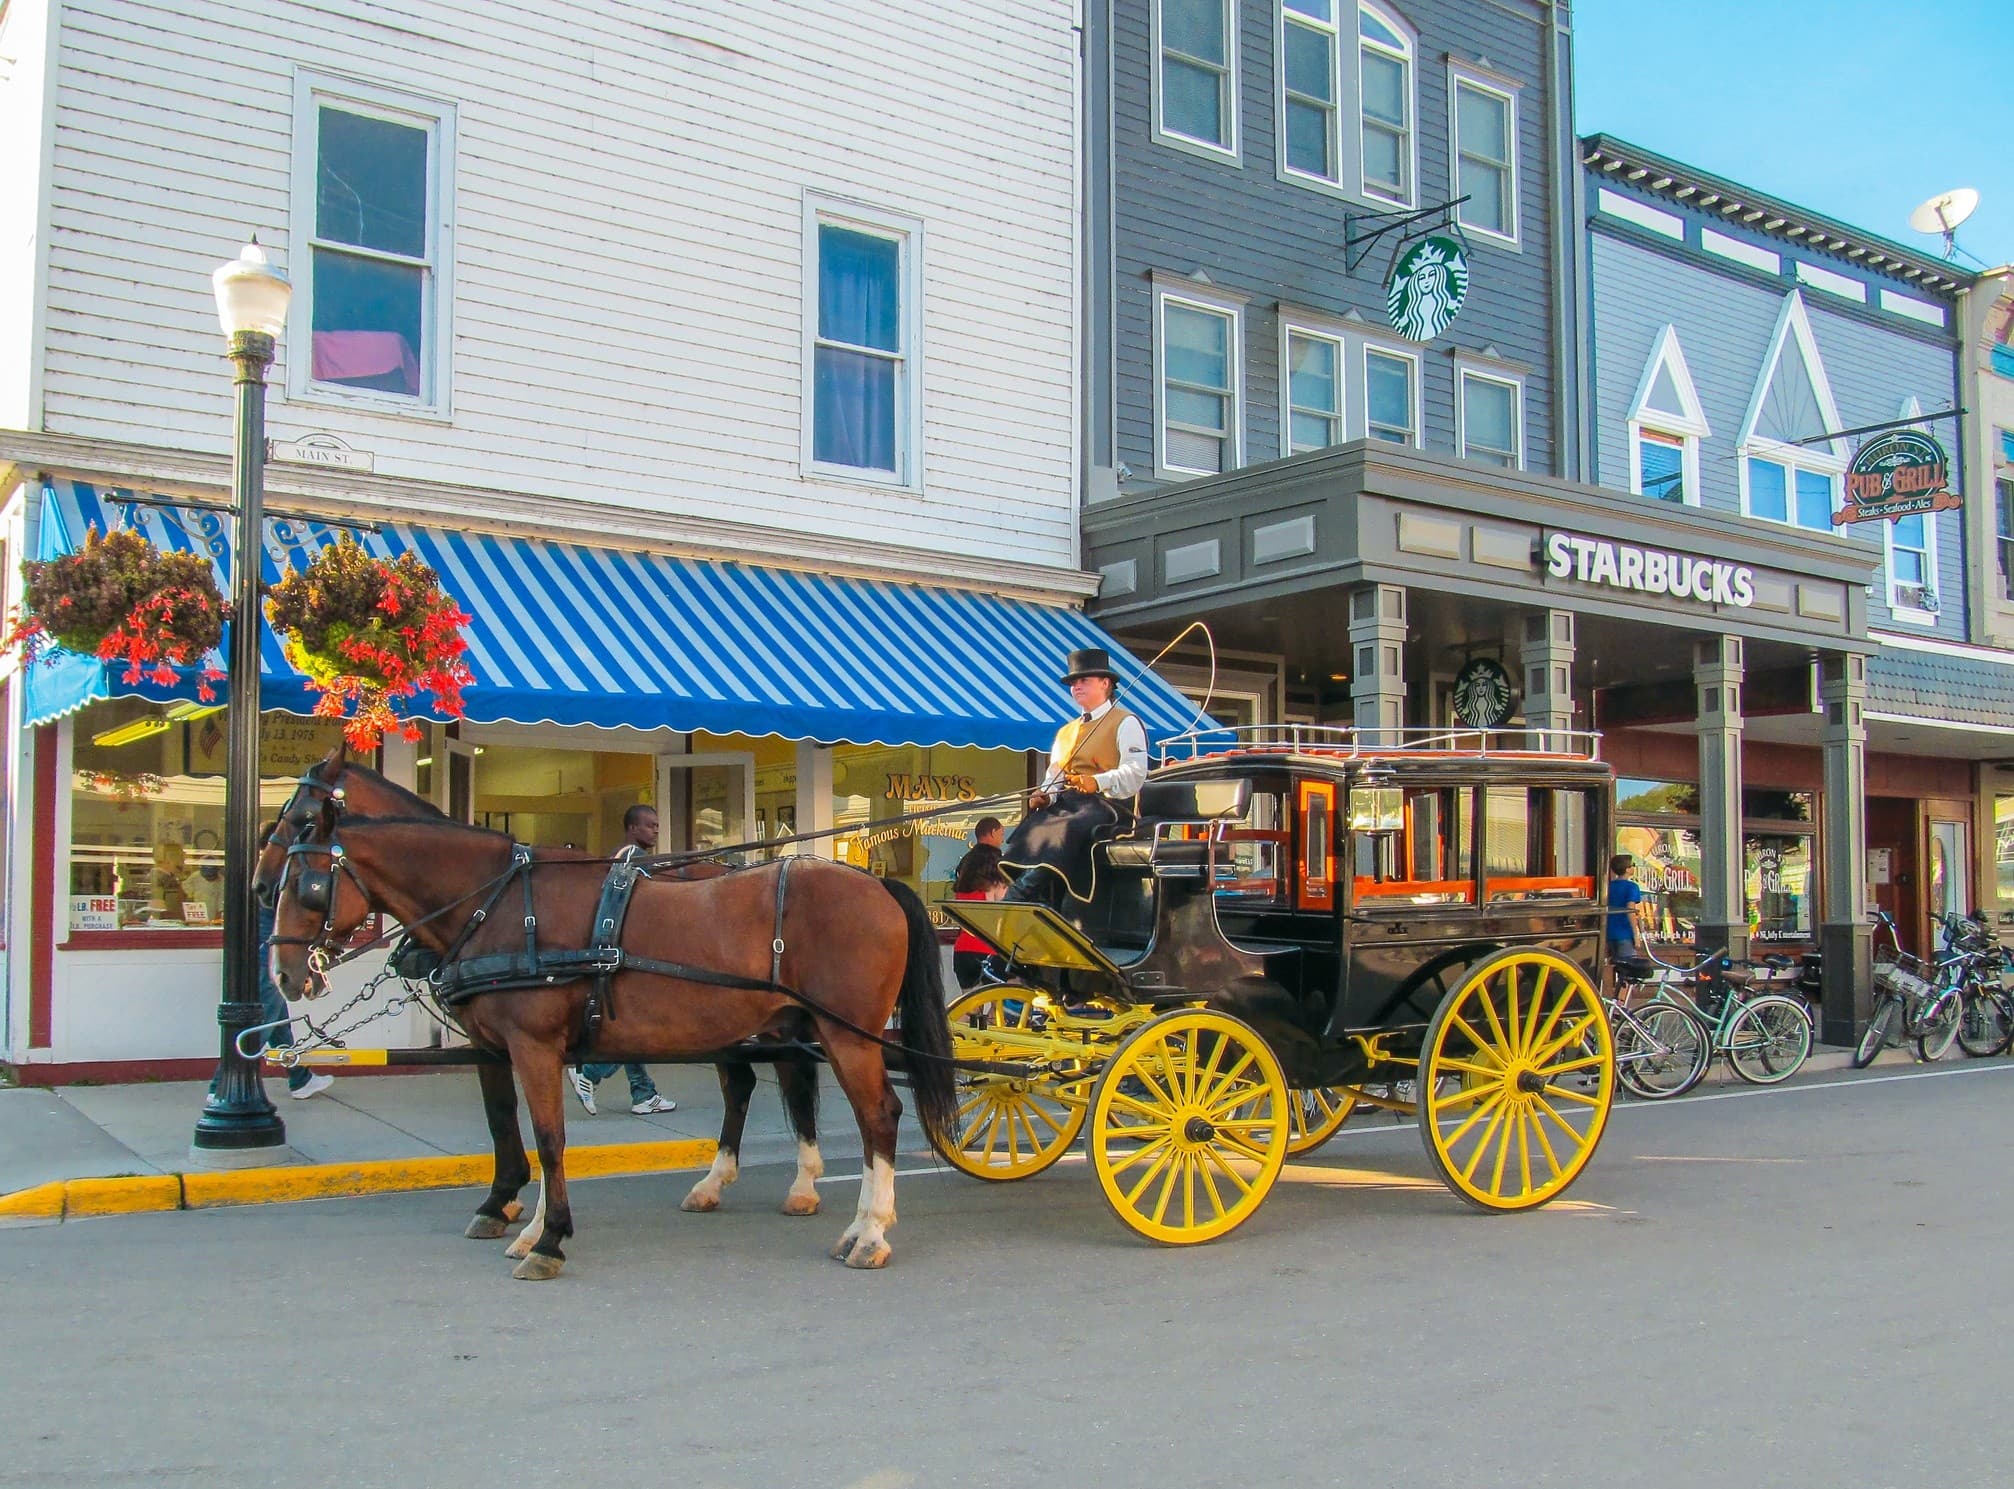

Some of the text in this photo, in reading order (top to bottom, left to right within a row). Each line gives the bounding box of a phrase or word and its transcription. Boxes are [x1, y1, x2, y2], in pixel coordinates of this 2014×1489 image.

[296, 448, 329, 461] MAIN
[1846, 464, 1946, 502] PUB & GRILL
[1548, 534, 1753, 608] STARBUCKS
[291, 729, 315, 742] 1975
[885, 774, 977, 801] MAY'S
[850, 817, 968, 861] Famous Mackinac
[1664, 867, 1691, 893] GRILL
[90, 899, 116, 912] FREE
